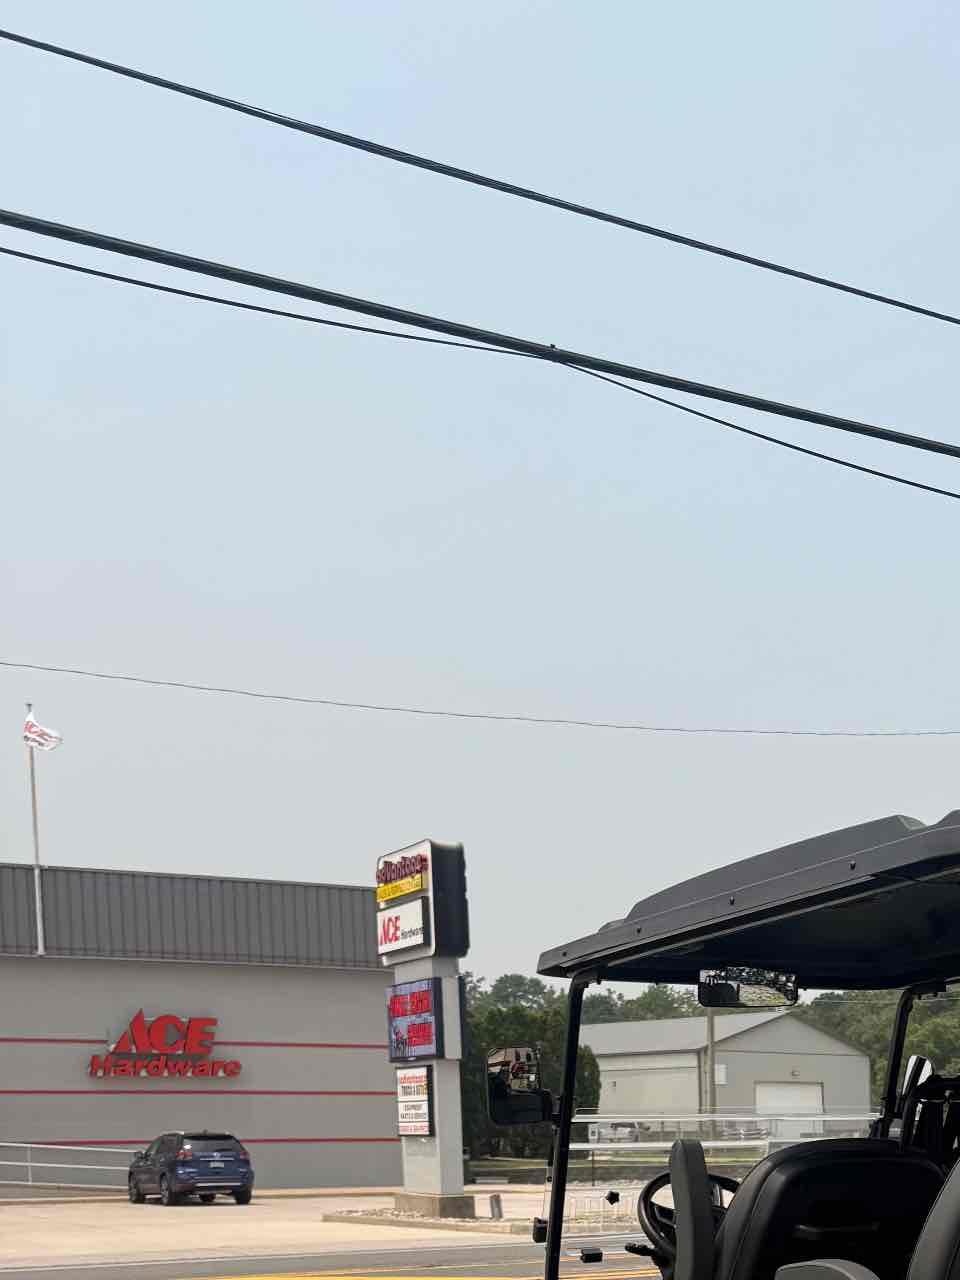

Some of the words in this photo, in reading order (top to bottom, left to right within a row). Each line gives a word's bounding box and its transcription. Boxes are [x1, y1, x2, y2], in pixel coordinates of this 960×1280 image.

[380, 916, 401, 945] ACE
[109, 1008, 218, 1055] ACE
[90, 1055, 242, 1077] Hardware
